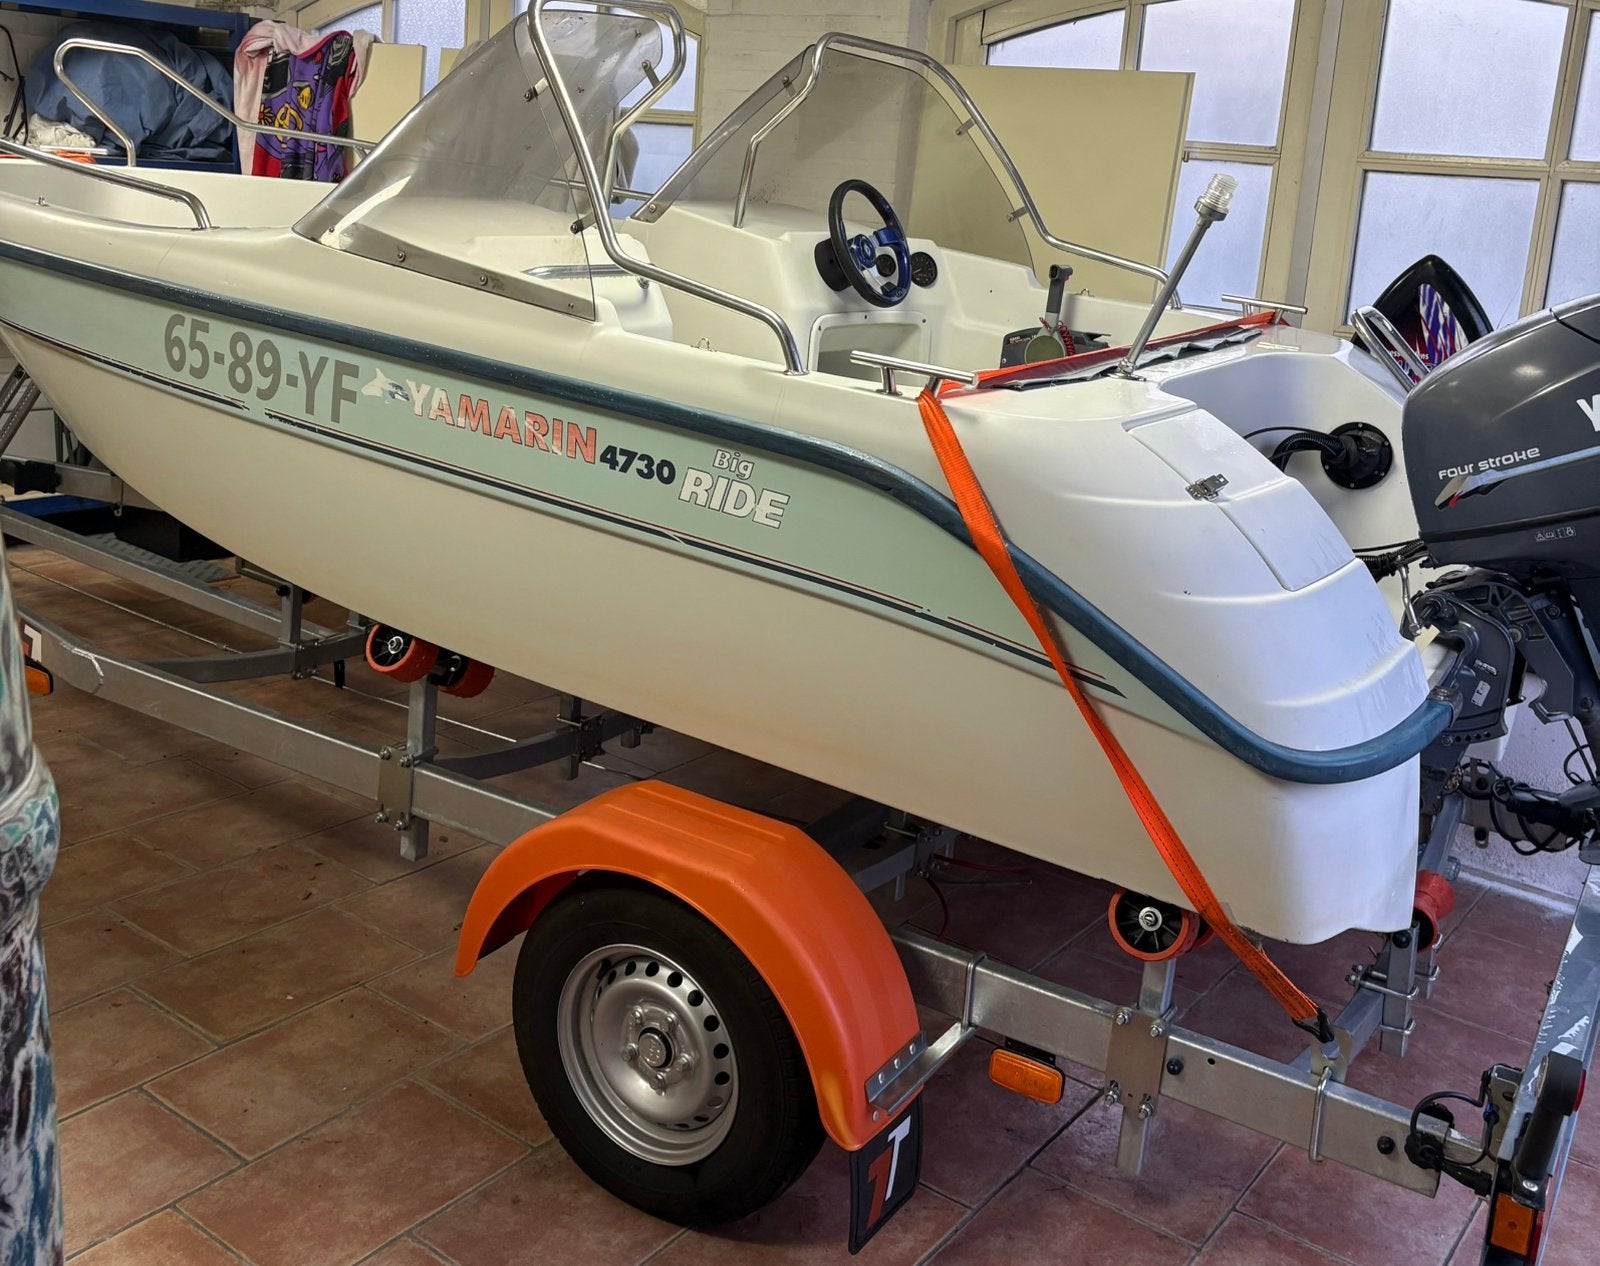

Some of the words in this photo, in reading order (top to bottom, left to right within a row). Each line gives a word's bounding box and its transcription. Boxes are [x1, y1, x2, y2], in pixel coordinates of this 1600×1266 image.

[164, 313, 360, 424] 65-89-YF
[405, 379, 598, 465] YAMARIN
[599, 445, 677, 486] 4730
[712, 448, 756, 481] Big
[1478, 447, 1541, 471] stroke
[678, 466, 791, 530] RIDE
